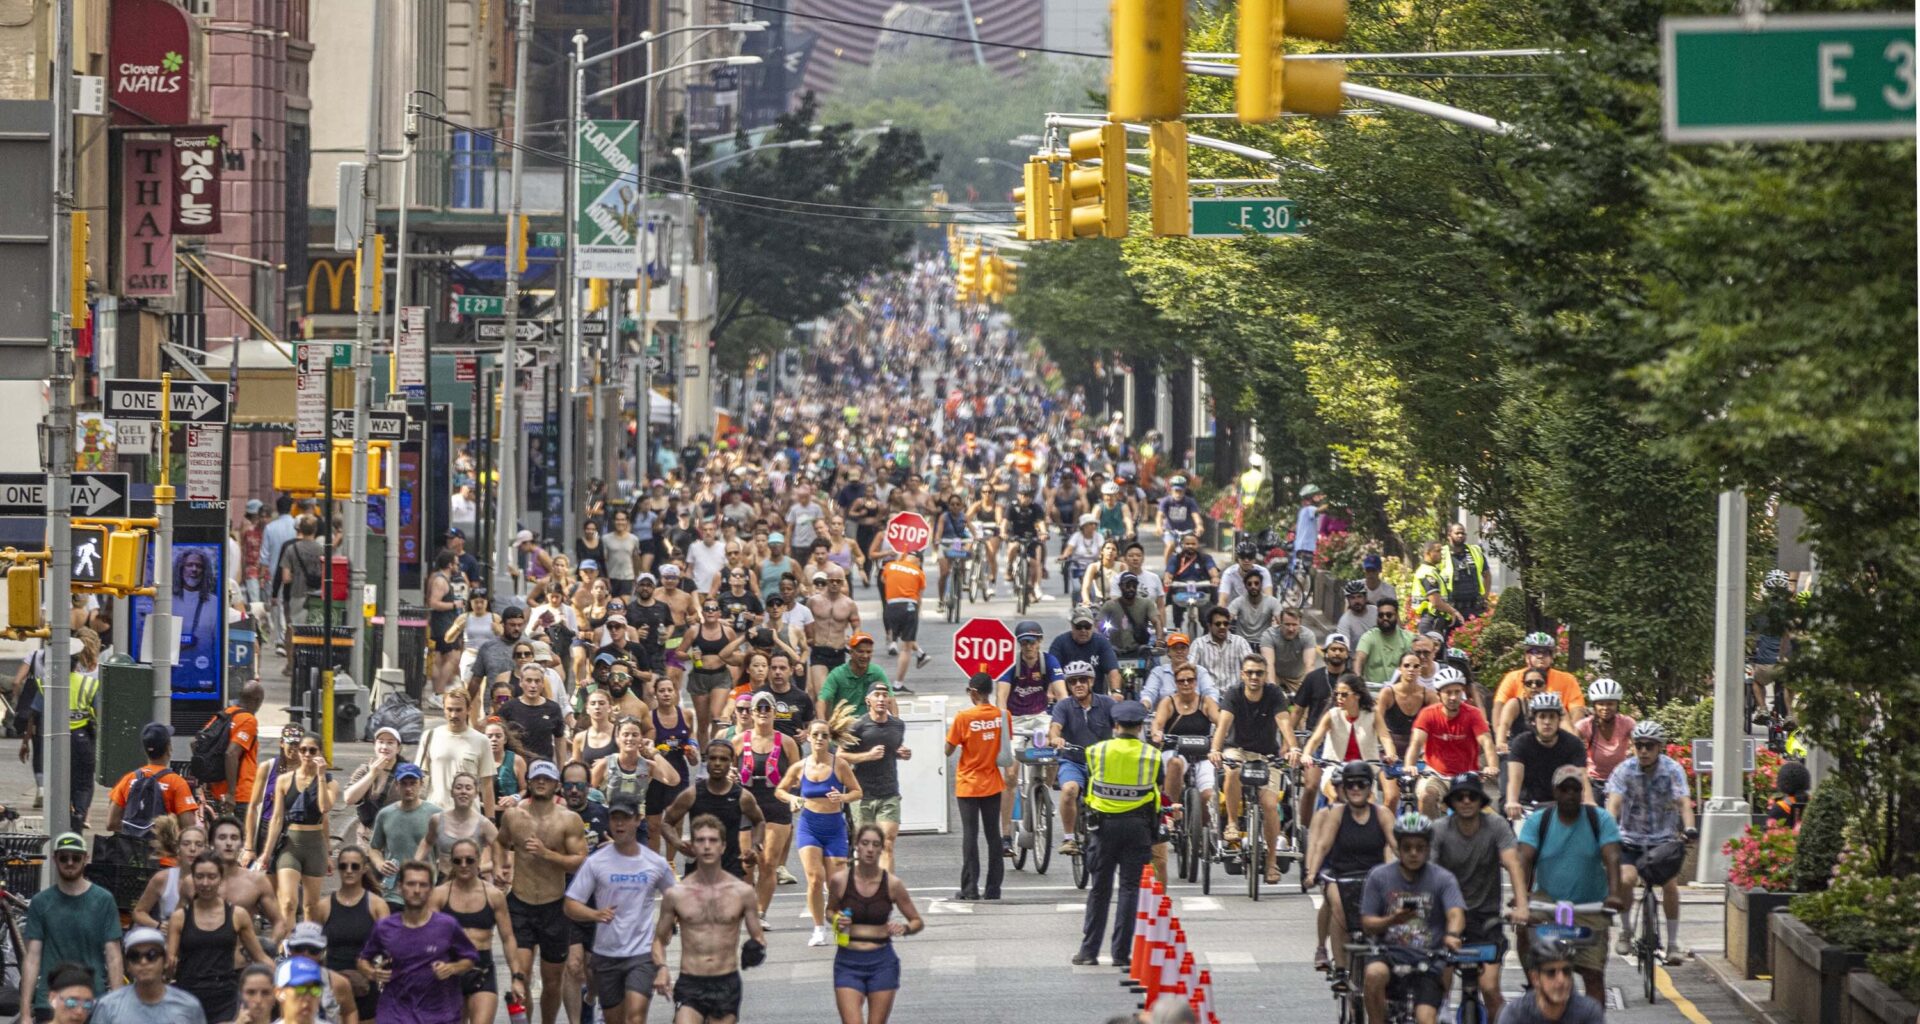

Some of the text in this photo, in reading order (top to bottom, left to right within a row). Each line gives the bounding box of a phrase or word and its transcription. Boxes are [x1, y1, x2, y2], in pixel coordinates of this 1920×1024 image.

[120, 64, 159, 74] Clover
[1817, 43, 1857, 110] E
[118, 76, 181, 93] NAILS
[174, 139, 206, 147] Clover
[580, 120, 633, 174] FLATIRON
[180, 151, 214, 225] NAILS
[134, 149, 163, 268] THAI
[585, 204, 630, 246] NOMAD
[1241, 207, 1290, 229] E 30
[128, 274, 169, 289] CAFE
[465, 299, 472, 312] E
[474, 299, 488, 312] 29
[122, 393, 208, 411] ONE WAY
[119, 425, 145, 435] GEL
[371, 420, 397, 431] WAY
[118, 436, 147, 445] REET
[189, 431, 197, 446] 3
[6, 487, 43, 503] ONE
[190, 501, 226, 509] LinkNYC
[889, 523, 928, 543] STOP
[236, 645, 248, 662] P
[956, 636, 1012, 661] STOP
[969, 719, 1003, 732] Staf
[1102, 787, 1138, 797] NYPD
